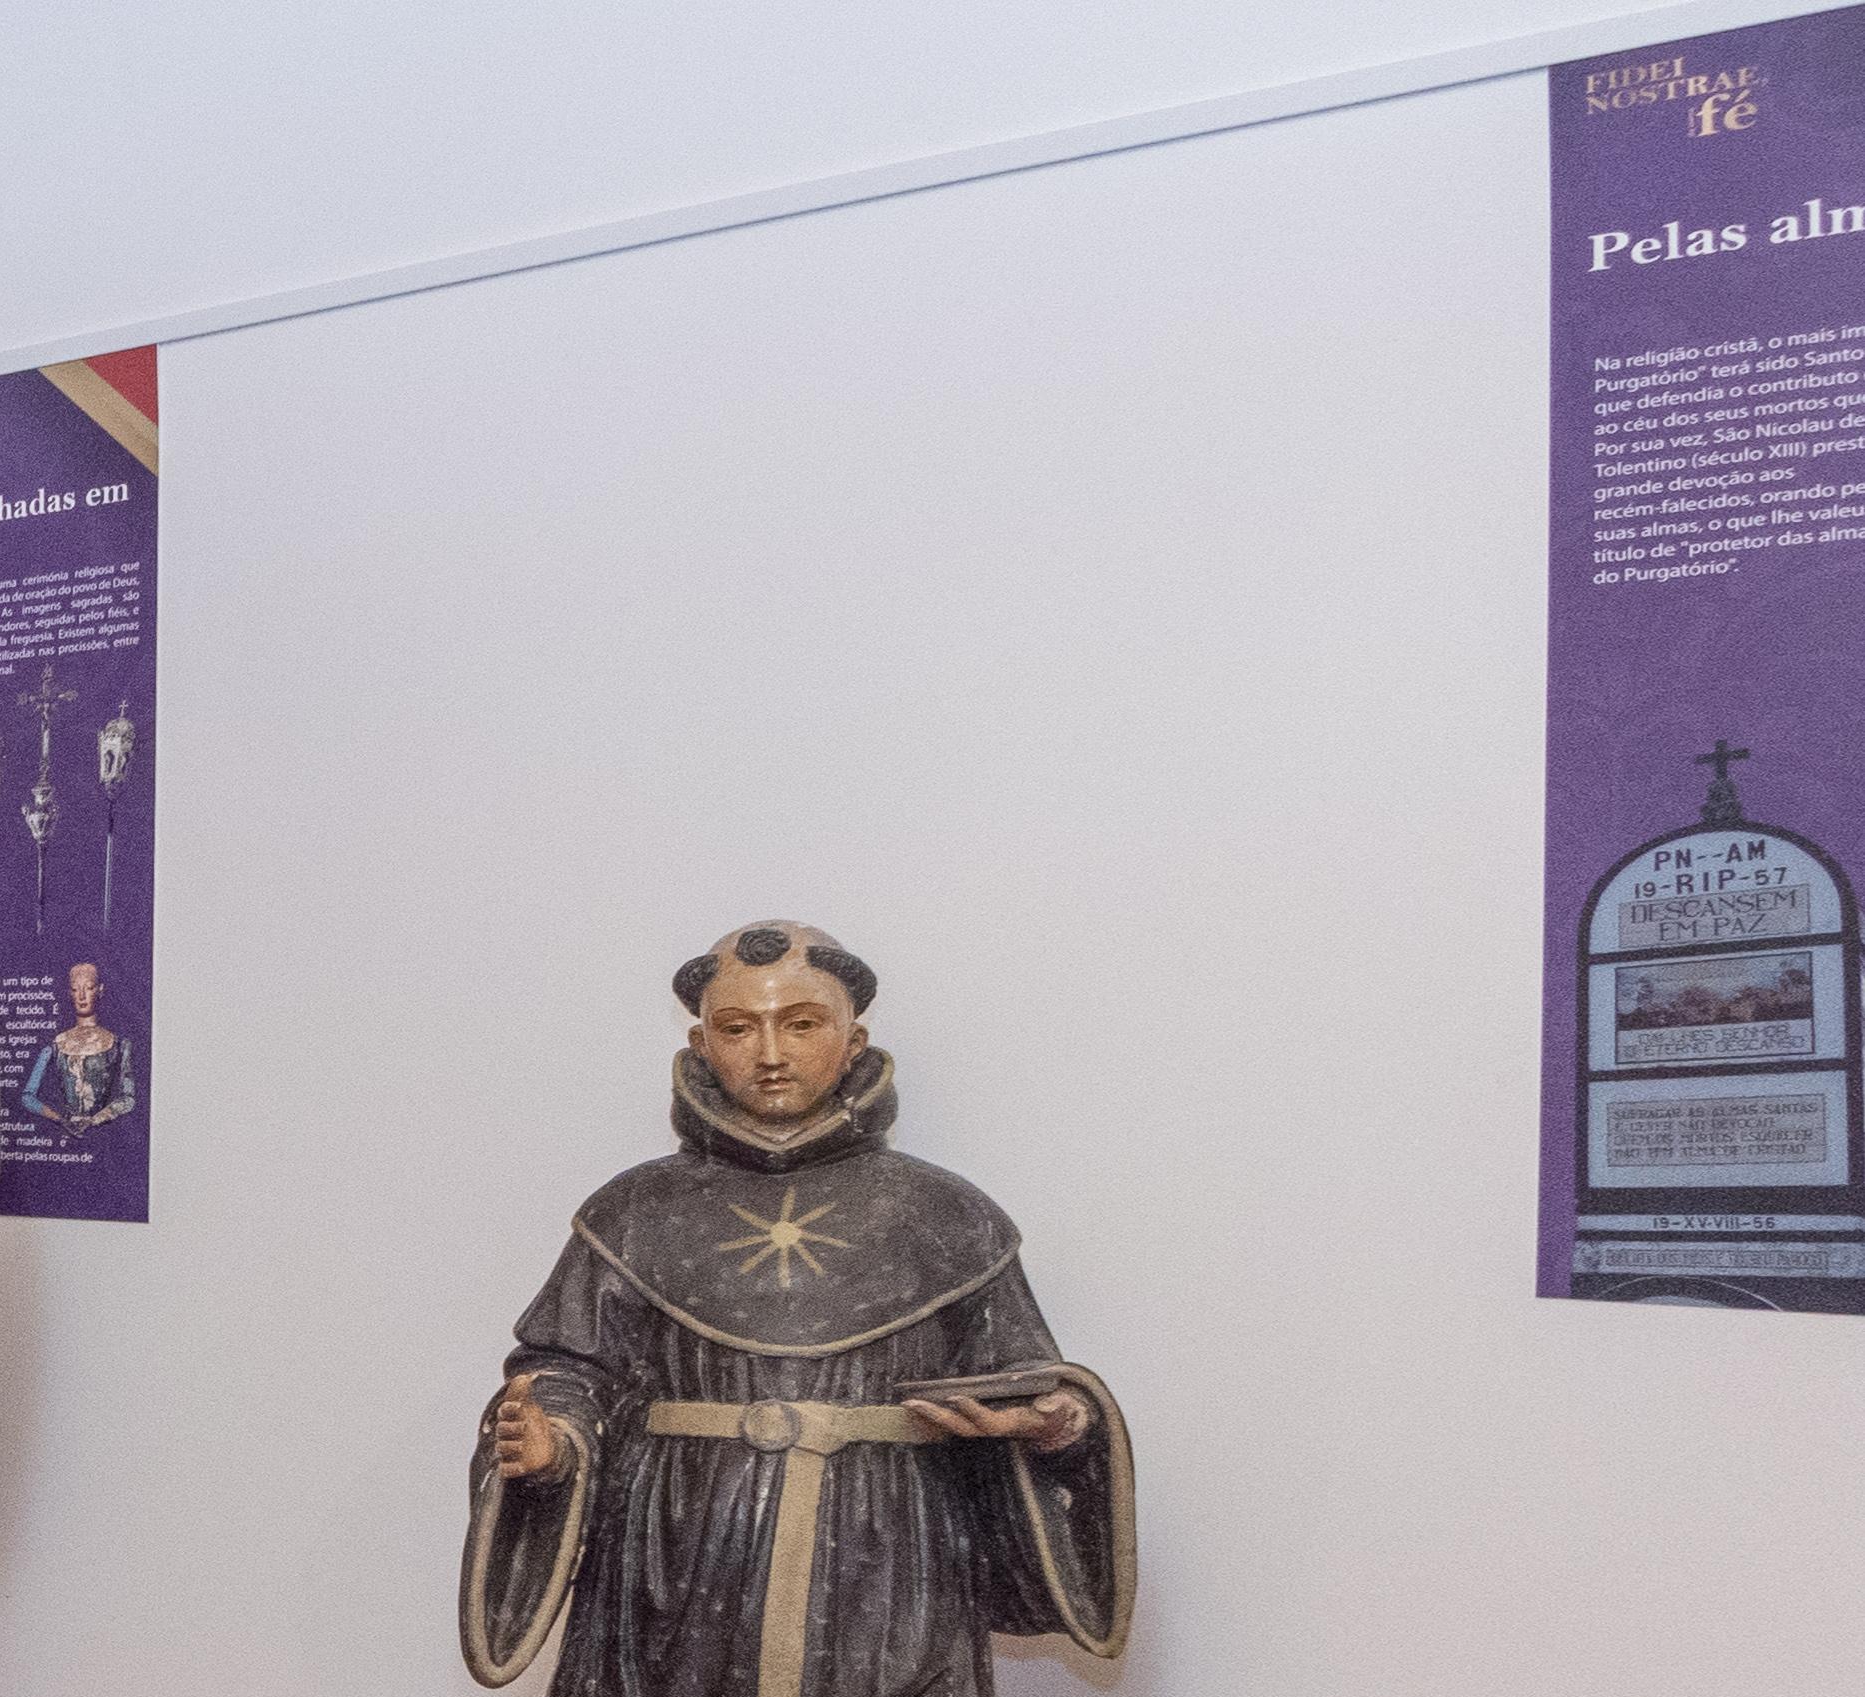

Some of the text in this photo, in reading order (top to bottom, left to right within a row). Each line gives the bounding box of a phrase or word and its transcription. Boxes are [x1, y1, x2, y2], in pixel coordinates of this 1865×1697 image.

[1586, 56, 1686, 94] FIDEI
[1697, 90, 1759, 137] fé
[1587, 221, 1748, 273] Pelas
[1594, 357, 1620, 371] Na
[1625, 346, 1699, 367] religião
[1703, 338, 1764, 358] cristã,
[1768, 338, 1782, 349] o
[1787, 330, 1836, 347] mais
[1710, 360, 1750, 378] terá
[1755, 355, 1799, 372] sido
[1803, 347, 1863, 366] Santo
[1594, 400, 1632, 417] que
[1636, 386, 1724, 408] defendia
[1729, 386, 1743, 397] o
[1747, 370, 1858, 395] contributo
[1594, 394, 1865, 435] ao céu dos seus mortos qu
[1594, 442, 1626, 456] Por
[1631, 439, 1665, 452] sua
[1670, 435, 1709, 448] vez,
[1713, 428, 1750, 443] São
[1755, 419, 1834, 438] Nicolau
[1594, 457, 1687, 478] Tolentino
[85, 483, 129, 507] em
[1594, 469, 1795, 502] grande devoção aos
[1759, 484, 1836, 504] orando
[1593, 528, 1637, 542] suas
[1640, 522, 1704, 537] almas,
[1708, 520, 1722, 531] o
[1726, 516, 1767, 532] que
[1771, 509, 1804, 525] lhe
[1592, 546, 1646, 563] título
[1649, 543, 1676, 558] de
[1776, 531, 1813, 545] das
[1592, 570, 1619, 584] do
[1630, 888, 1797, 924] DESCANSEM
[1659, 913, 1767, 941] EM PAZ
